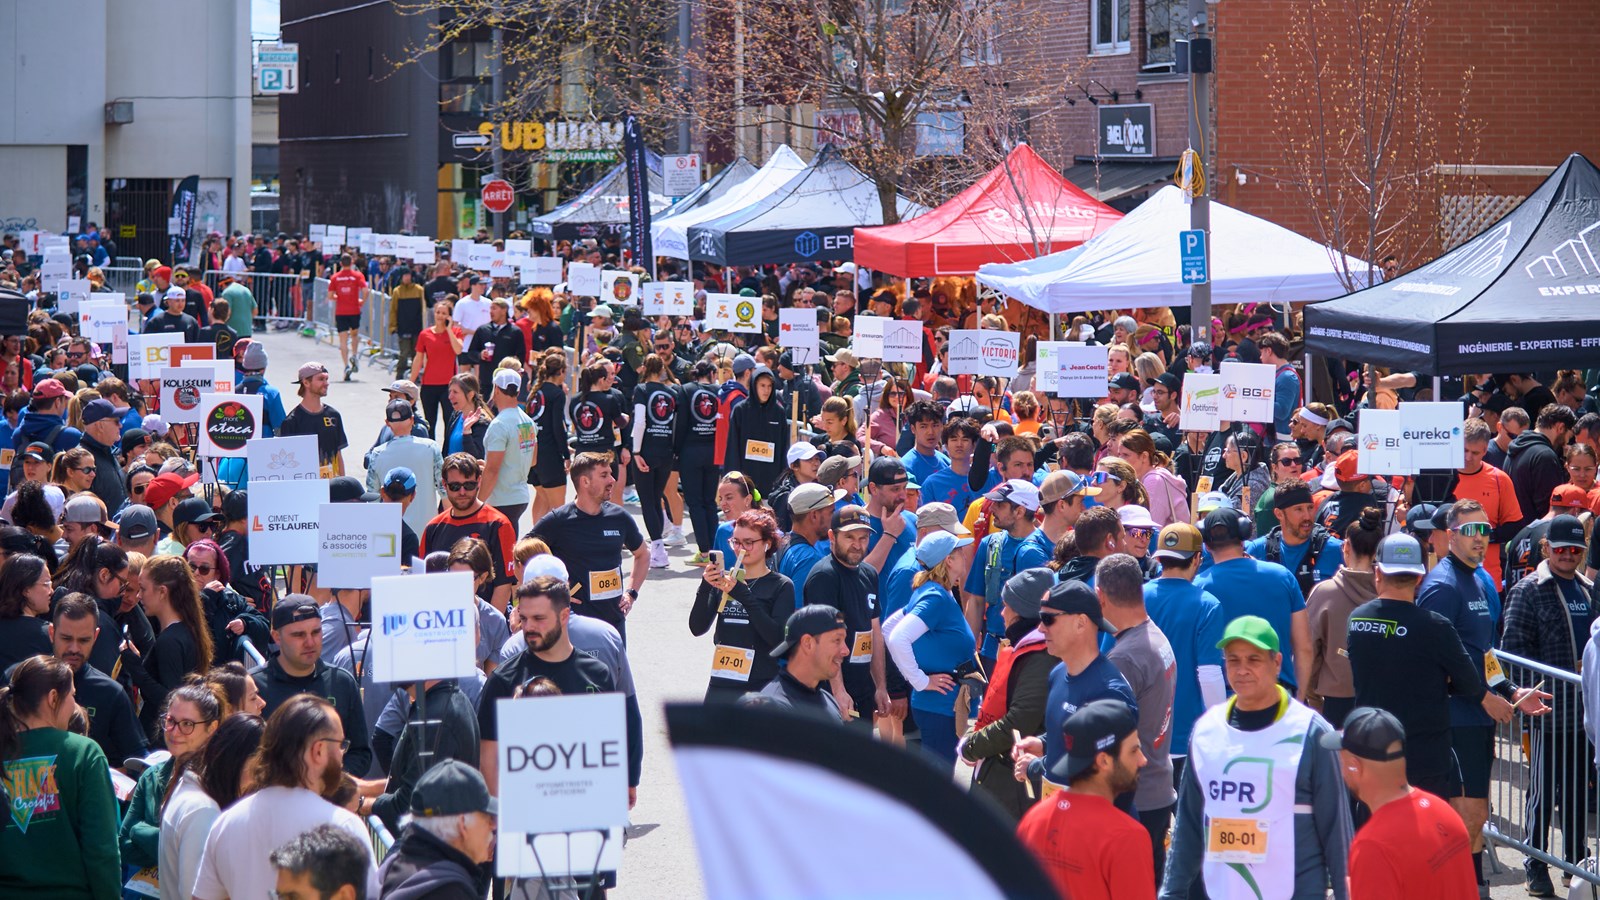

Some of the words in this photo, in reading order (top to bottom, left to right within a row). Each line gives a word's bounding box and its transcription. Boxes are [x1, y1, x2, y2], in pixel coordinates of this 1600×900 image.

[264, 71, 277, 88] P
[546, 152, 616, 161] RESTAURANT
[484, 190, 512, 202] ARRÊT
[1012, 201, 1096, 220] Joliette
[1186, 234, 1198, 254] P
[1538, 284, 1600, 297] EXPER
[146, 346, 168, 362] BC
[981, 346, 1017, 361] VICTORIA
[1458, 342, 1513, 354] INGÉNIERIE
[1520, 339, 1574, 350] EXPERTISE
[1242, 388, 1272, 398] BGC
[208, 422, 253, 434] atoca
[1403, 427, 1450, 440] eureka
[268, 514, 299, 523] CIMENT
[268, 522, 319, 531] ST-LAUREN
[330, 541, 367, 550] associés
[599, 578, 618, 588] 08-01
[413, 608, 466, 630] GMI
[1350, 618, 1407, 638] MODERNO
[720, 656, 744, 668] 47-01
[507, 741, 620, 773] DOYLE
[3, 764, 60, 800] SHACK
[1209, 780, 1256, 803] GPR
[14, 793, 55, 811] Crossfit
[1220, 831, 1256, 846] 80-01
